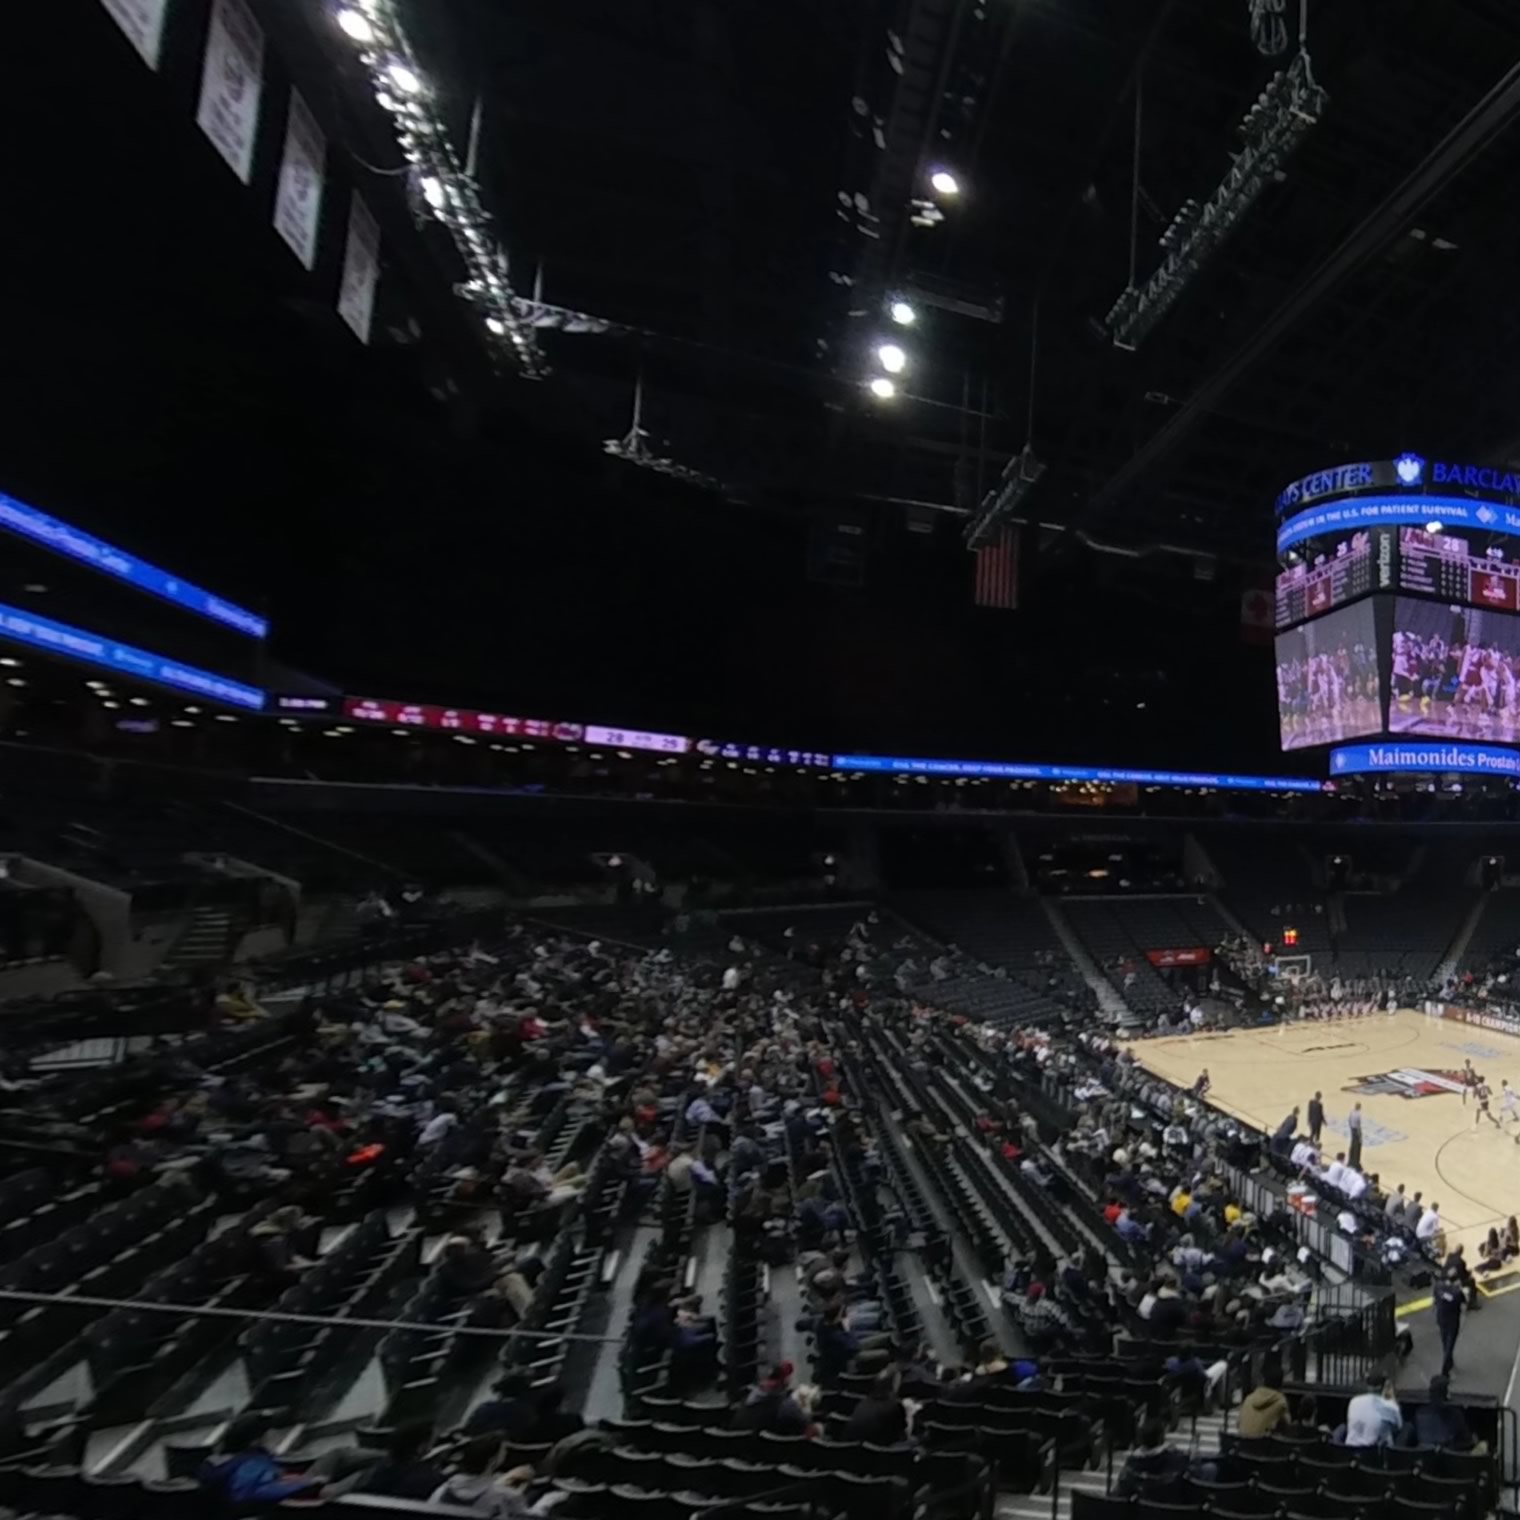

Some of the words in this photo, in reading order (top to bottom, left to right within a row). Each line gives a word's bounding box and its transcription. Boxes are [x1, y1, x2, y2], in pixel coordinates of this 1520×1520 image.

[1302, 463, 1372, 498] CENTER
[1361, 506, 1379, 517] FOR
[1381, 504, 1419, 515] PATIENT
[1421, 504, 1468, 517] SURVIVAL
[1443, 537, 1460, 552] 28
[1378, 533, 1391, 588] verizon
[1368, 747, 1475, 767] Maimonides
